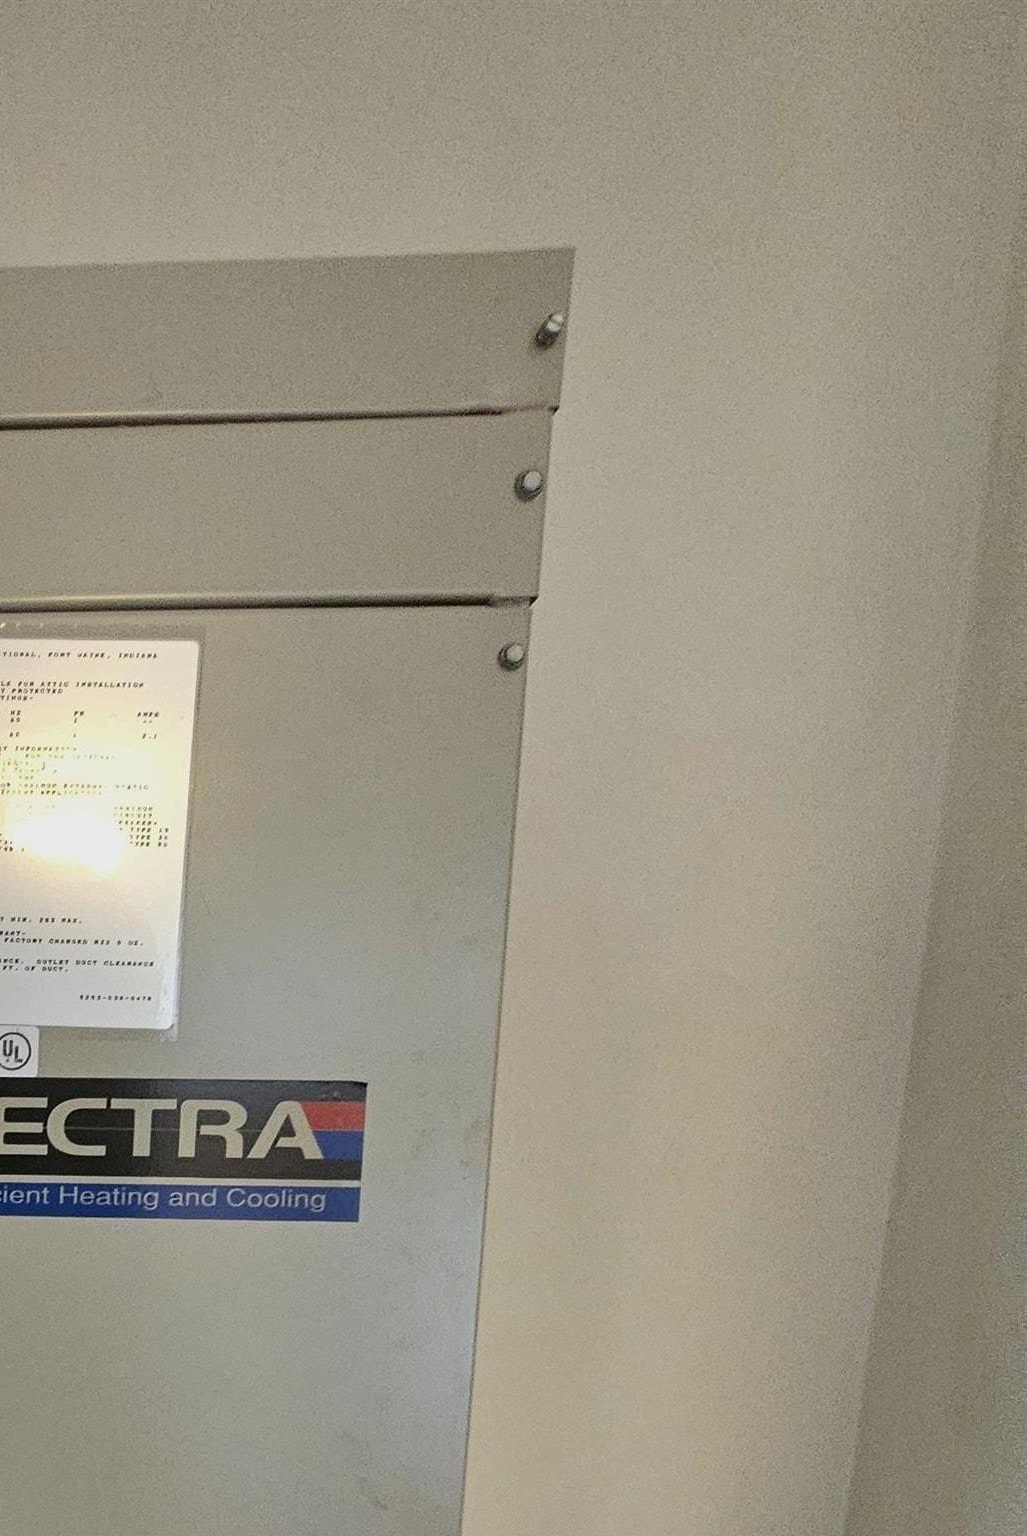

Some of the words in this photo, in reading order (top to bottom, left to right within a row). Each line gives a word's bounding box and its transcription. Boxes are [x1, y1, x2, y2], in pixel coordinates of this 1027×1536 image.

[59, 1185, 159, 1210] Heating
[169, 1188, 217, 1207] and
[226, 1188, 326, 1212] Cooling
